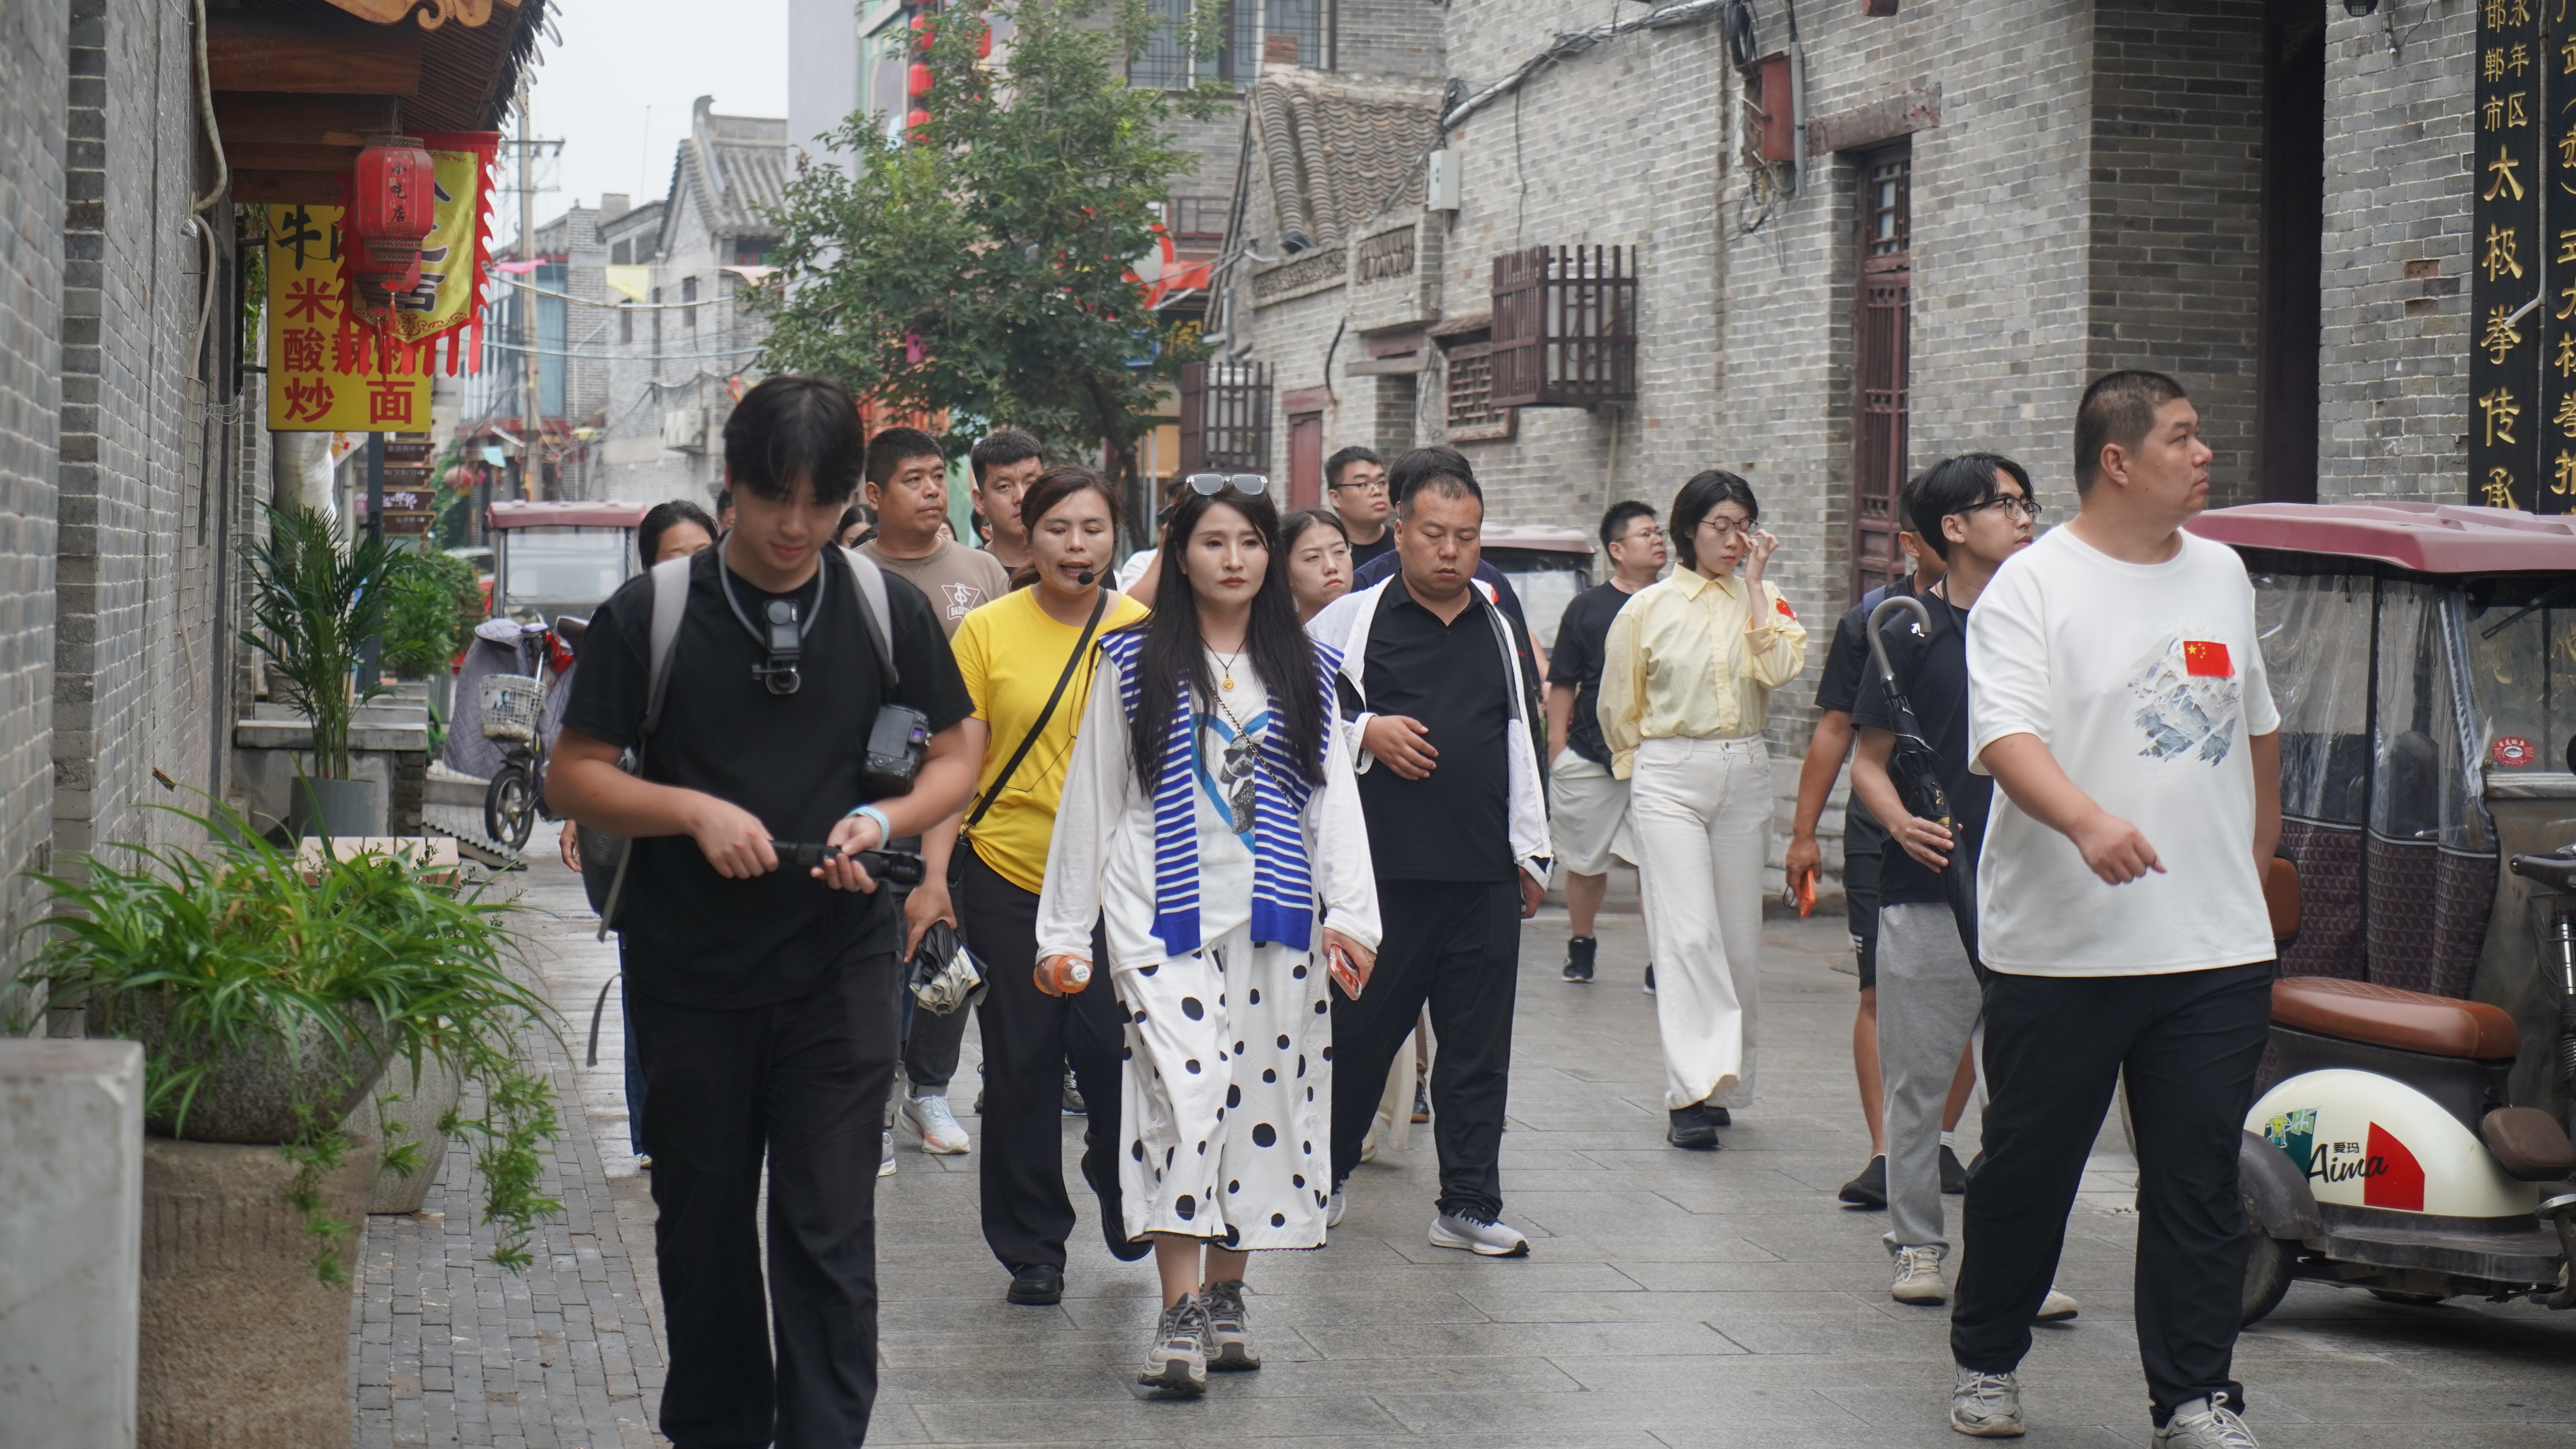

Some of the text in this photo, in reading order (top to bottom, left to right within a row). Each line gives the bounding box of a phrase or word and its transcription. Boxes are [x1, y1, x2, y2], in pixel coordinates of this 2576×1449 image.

[2482, 0, 2506, 132] 邯郸市
[2508, 0, 2530, 127] 永年区
[390, 161, 407, 222] 小吃店
[2479, 144, 2524, 510] 太极拳传承
[284, 378, 415, 424] 炒面
[2306, 1143, 2388, 1183] Aima
[2333, 1142, 2359, 1153] 爱玛
